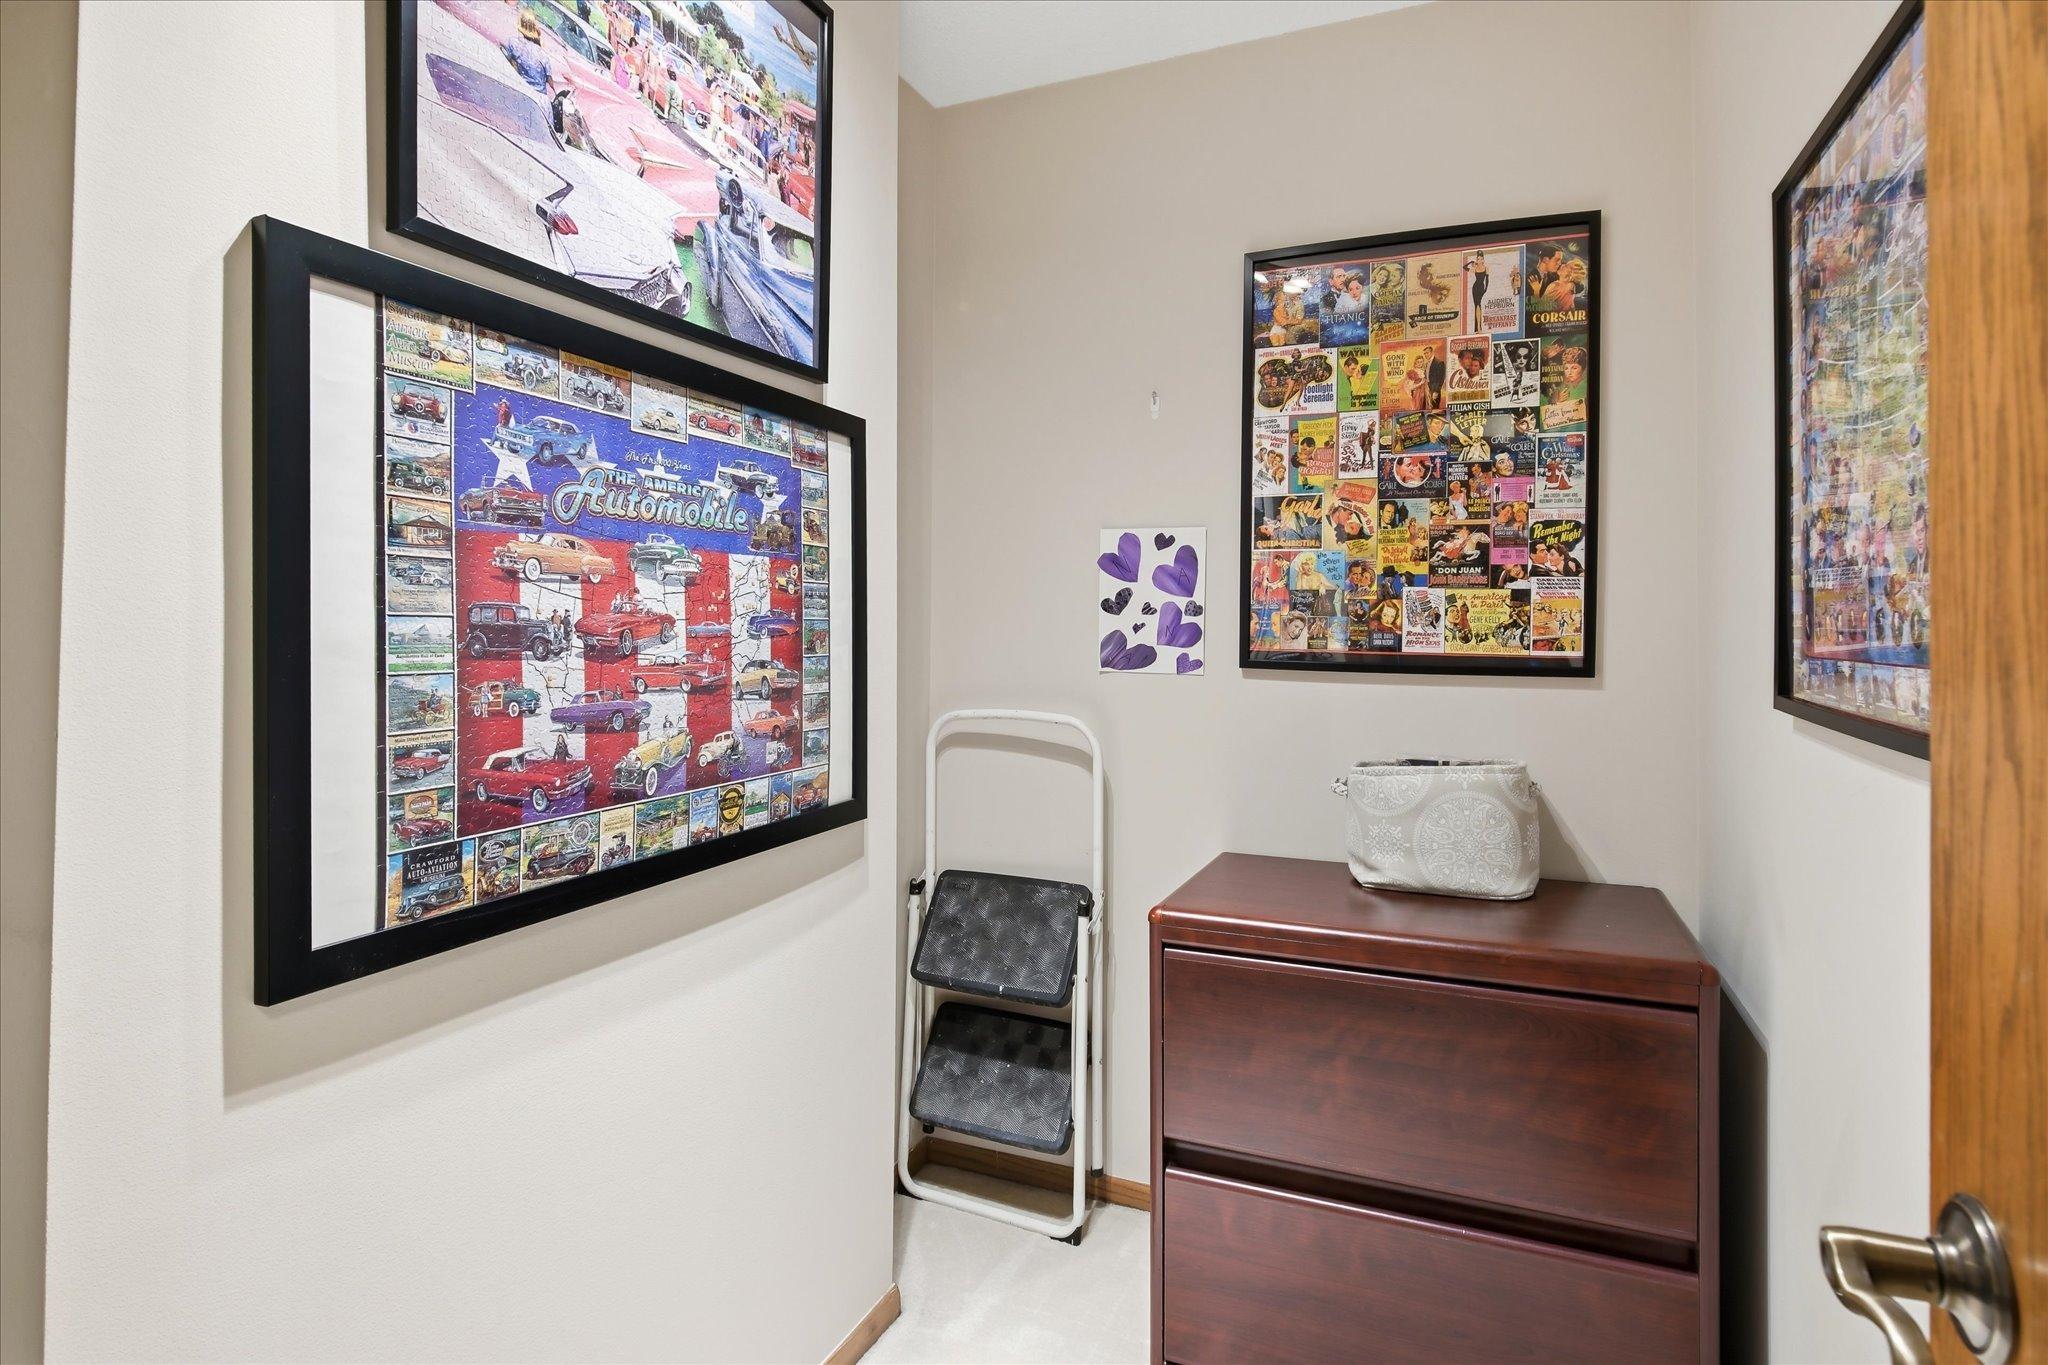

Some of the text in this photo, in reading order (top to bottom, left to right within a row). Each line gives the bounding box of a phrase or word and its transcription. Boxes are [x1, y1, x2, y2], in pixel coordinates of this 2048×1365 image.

[1484, 302, 1515, 310] HEPBURN
[1487, 297, 1513, 305] AUDREY
[1325, 312, 1365, 324] TITANIC
[1532, 310, 1587, 324] CORSAIR
[1304, 383, 1334, 394] Footlight
[1494, 386, 1510, 395] BETTE
[1522, 388, 1537, 396] STAR
[1303, 392, 1334, 403] Serenade
[1495, 390, 1511, 399] DAVIS
[1456, 411, 1487, 425] SCARLET
[1460, 418, 1487, 429] LETTER
[1510, 441, 1535, 451] COLBER
[1552, 441, 1575, 453] White
[1541, 447, 1580, 459] Christmas
[606, 469, 636, 485] THE
[553, 465, 749, 533] Automobile
[1533, 520, 1575, 539] Remember
[1546, 528, 1582, 546] the Night
[1323, 559, 1340, 567] seven
[1327, 566, 1339, 574] year
[1430, 575, 1488, 584] JOHN BARRYMORE
[1470, 600, 1504, 609] in Paris
[1485, 615, 1501, 623] KELLY
[410, 855, 456, 870] CRAWFORD
[407, 861, 458, 880] AUTO-AVIATION
